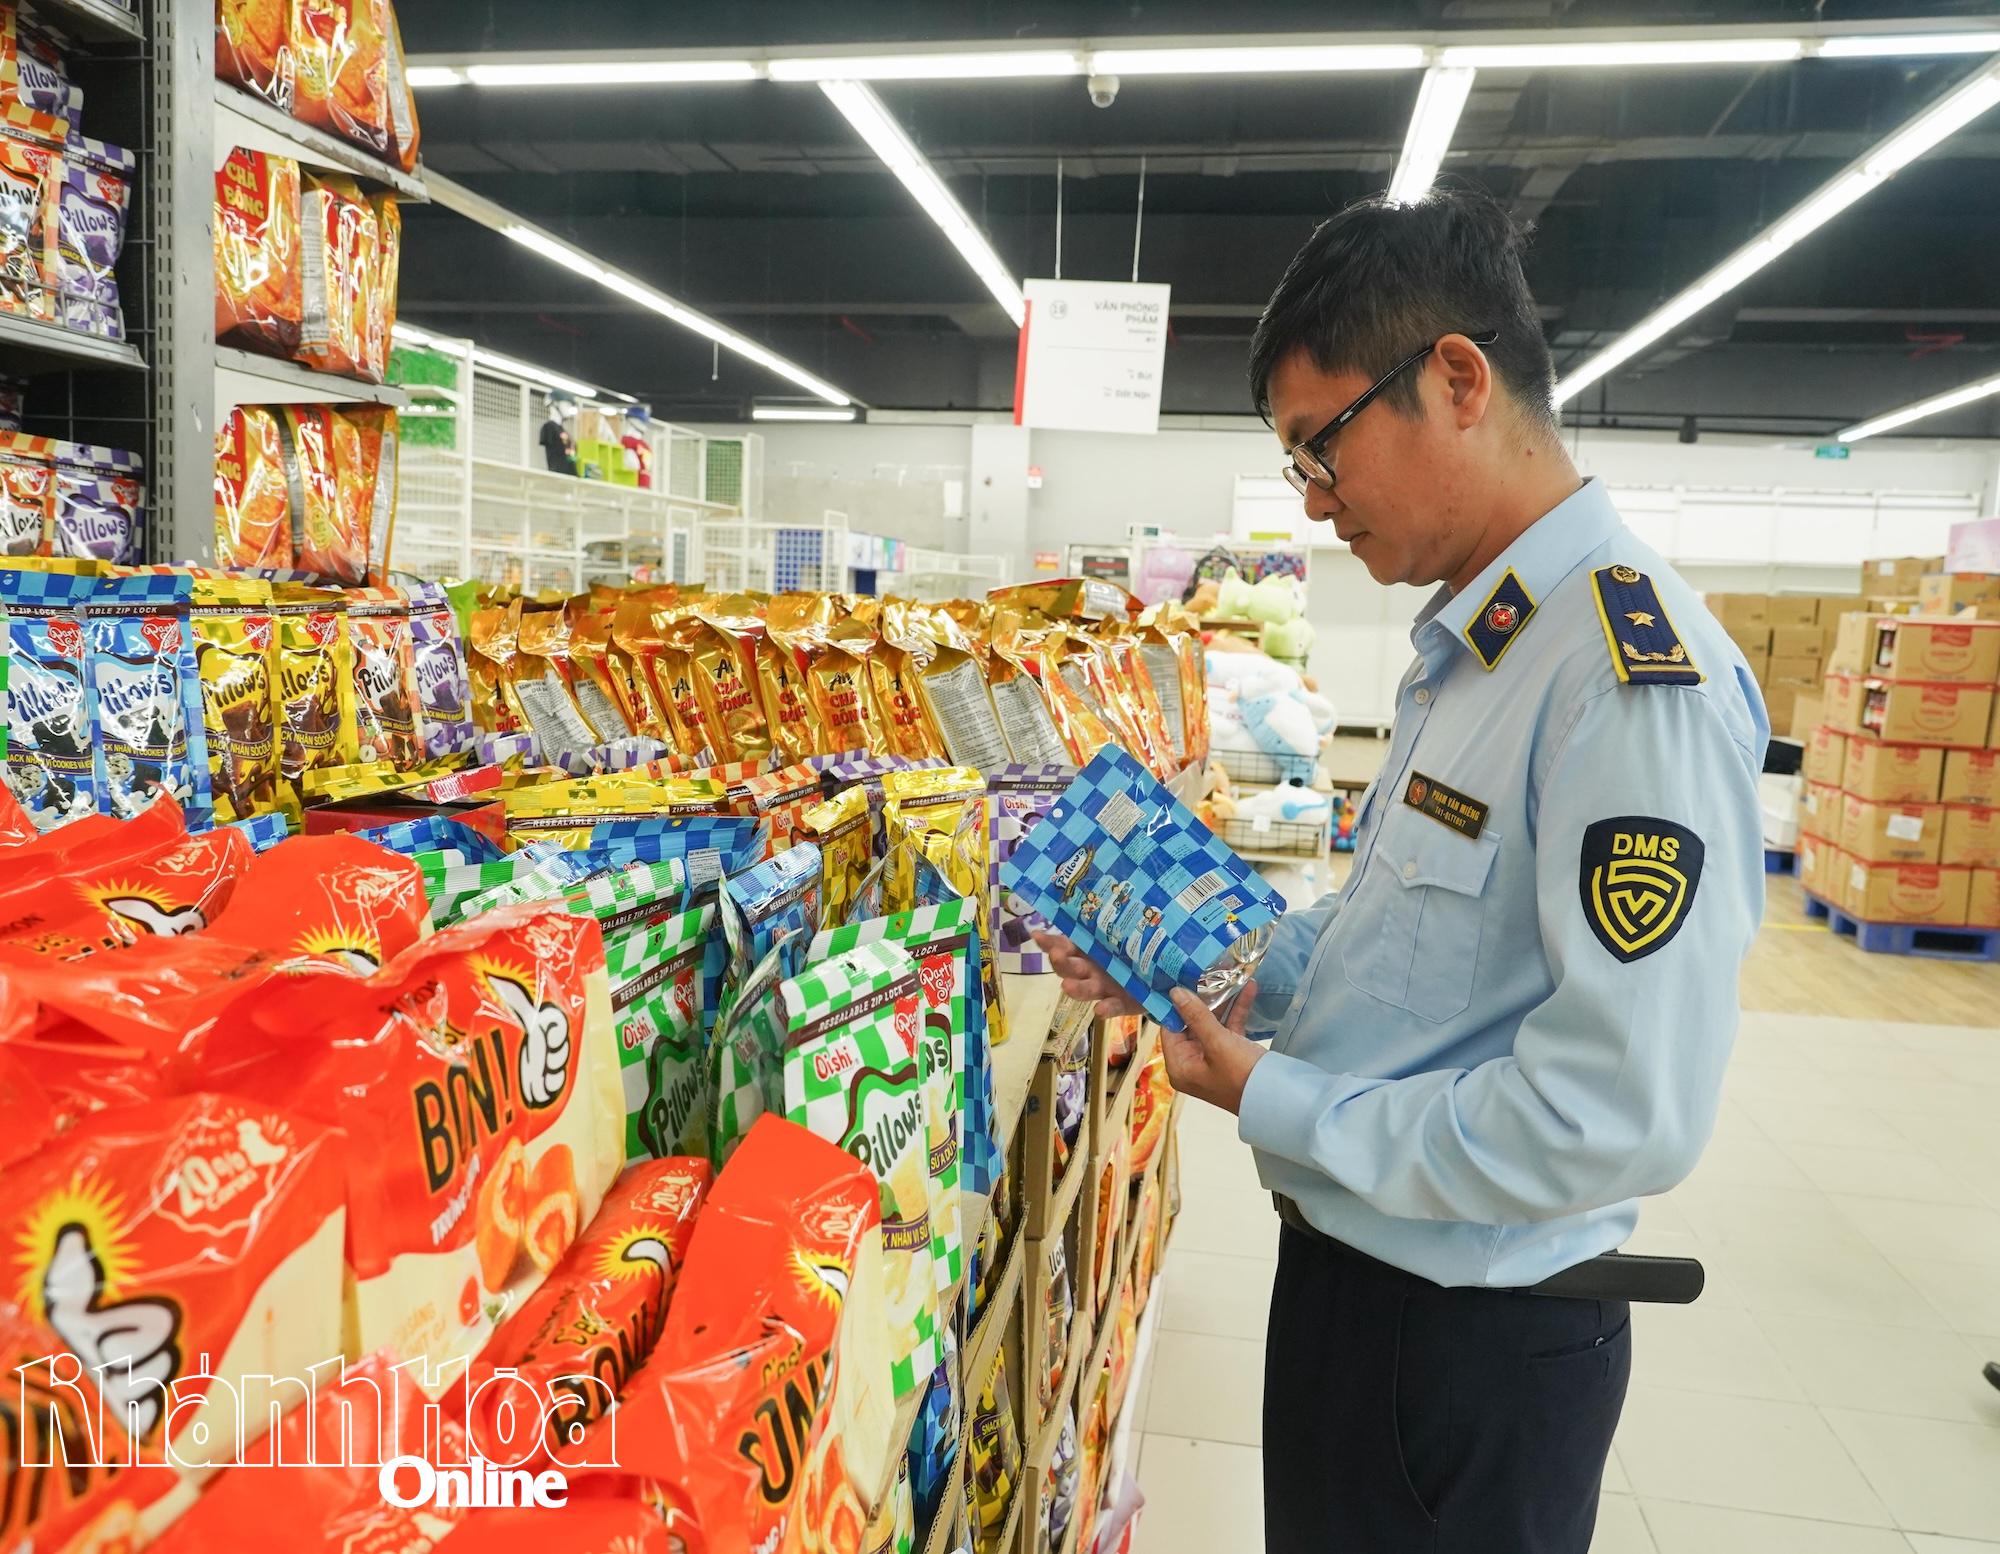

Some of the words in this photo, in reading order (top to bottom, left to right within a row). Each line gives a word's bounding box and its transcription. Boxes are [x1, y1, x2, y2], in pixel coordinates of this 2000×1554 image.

[60, 204, 118, 234] Pillows
[64, 518, 127, 545] Pillows
[88, 607, 113, 615] ABLE
[115, 606, 131, 615] ZIP
[131, 606, 158, 614] LOCK
[415, 656, 457, 694] Pillows
[100, 673, 174, 715] illows
[831, 706, 869, 727] BÔNG
[672, 806, 686, 814] ZIP
[686, 805, 706, 813] LOCK
[1612, 833, 1680, 862] DMS
[1058, 849, 1085, 888] Pillows
[915, 944, 938, 958] LOCK
[620, 975, 659, 1004] RESEALABLE
[658, 967, 670, 983] ZIP
[669, 958, 685, 976] LOCK
[920, 961, 954, 991] Party
[818, 1000, 869, 1033] RESEALABLE
[870, 993, 883, 1008] ZIP
[883, 985, 904, 1002] LOCK
[622, 1018, 651, 1051] Oishi
[814, 1044, 852, 1081] Oishi
[413, 1028, 512, 1195] BON!
[891, 1230, 912, 1248] NHÂN
